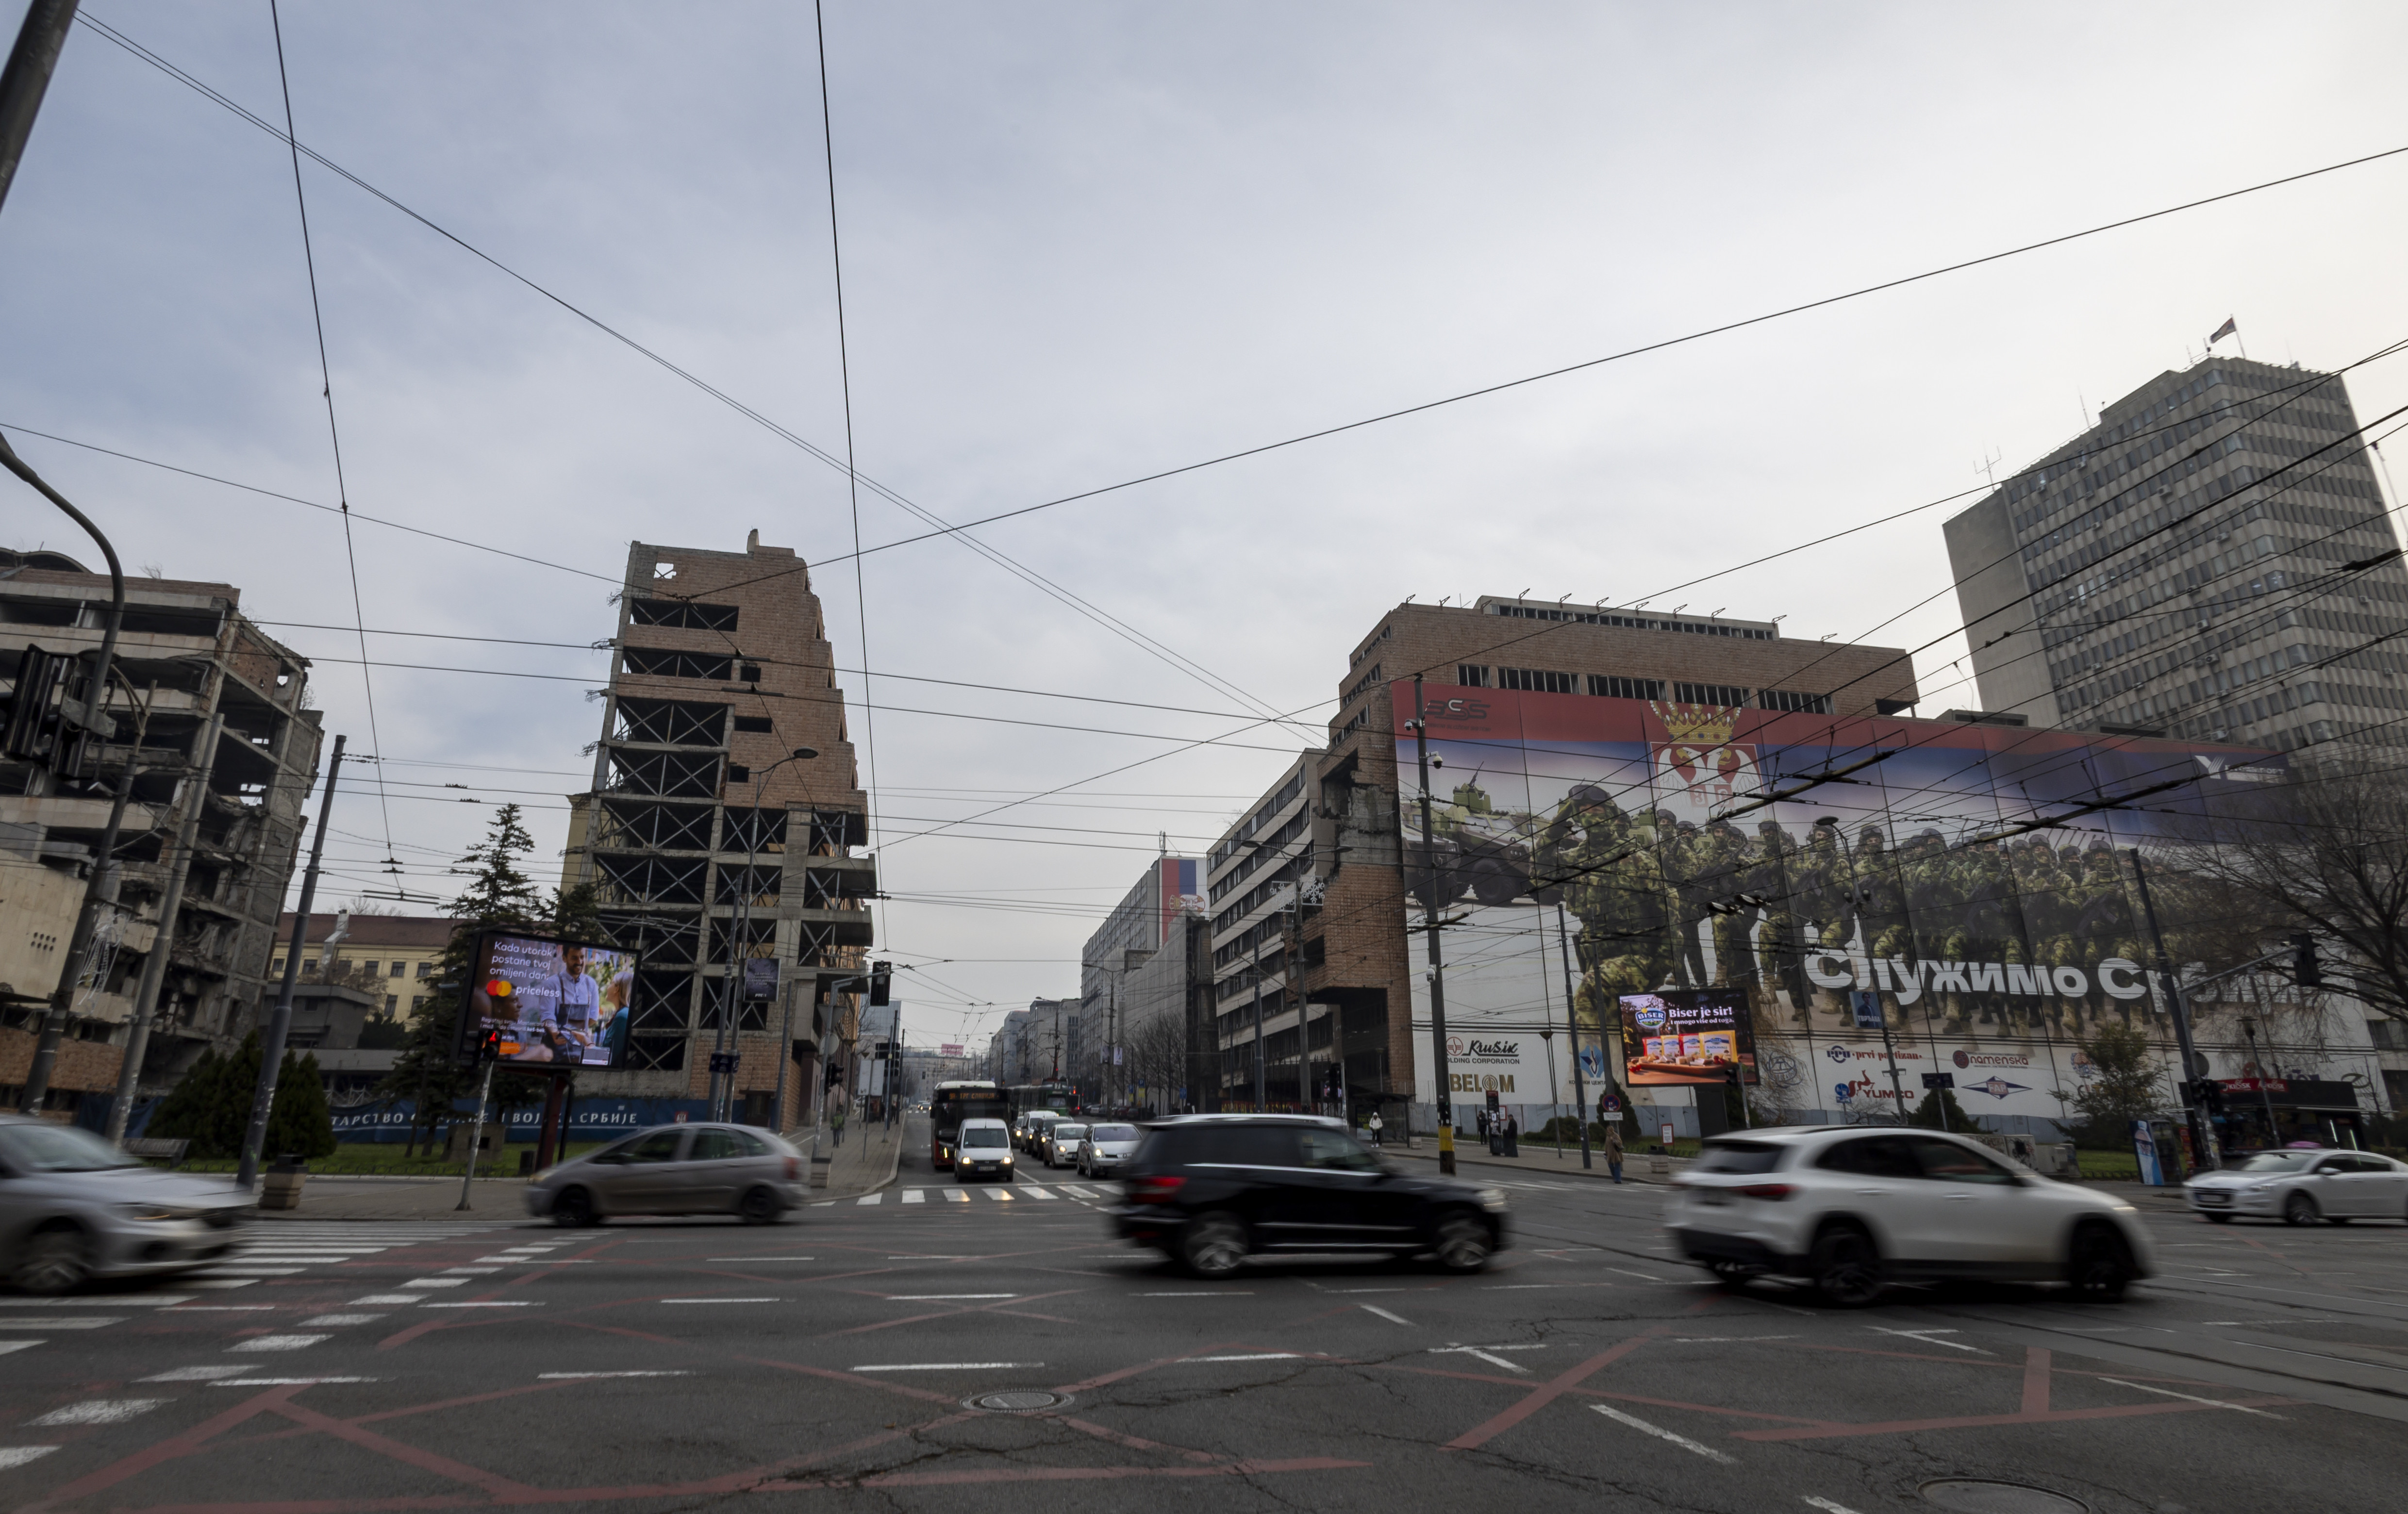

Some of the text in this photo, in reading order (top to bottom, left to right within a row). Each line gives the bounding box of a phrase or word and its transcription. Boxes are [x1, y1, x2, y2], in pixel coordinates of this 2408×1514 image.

[494, 941, 552, 956] Kada utorak
[492, 955, 551, 971] postane tvoj
[490, 968, 549, 980] omiljeni dan:
[1804, 949, 2088, 1006] Служимо
[515, 986, 560, 998] priceless
[1669, 1006, 1733, 1019] Biser je sir!
[1856, 1050, 1875, 1061] prvi
[1877, 1051, 1919, 1061] patizan
[1970, 1056, 2029, 1066] namenska
[1449, 1073, 1515, 1093] BELOM
[1988, 1084, 2006, 1093] FAP
[332, 1113, 404, 1126] ТАРСТВО
[580, 1112, 637, 1125] СРБИЈЕ
